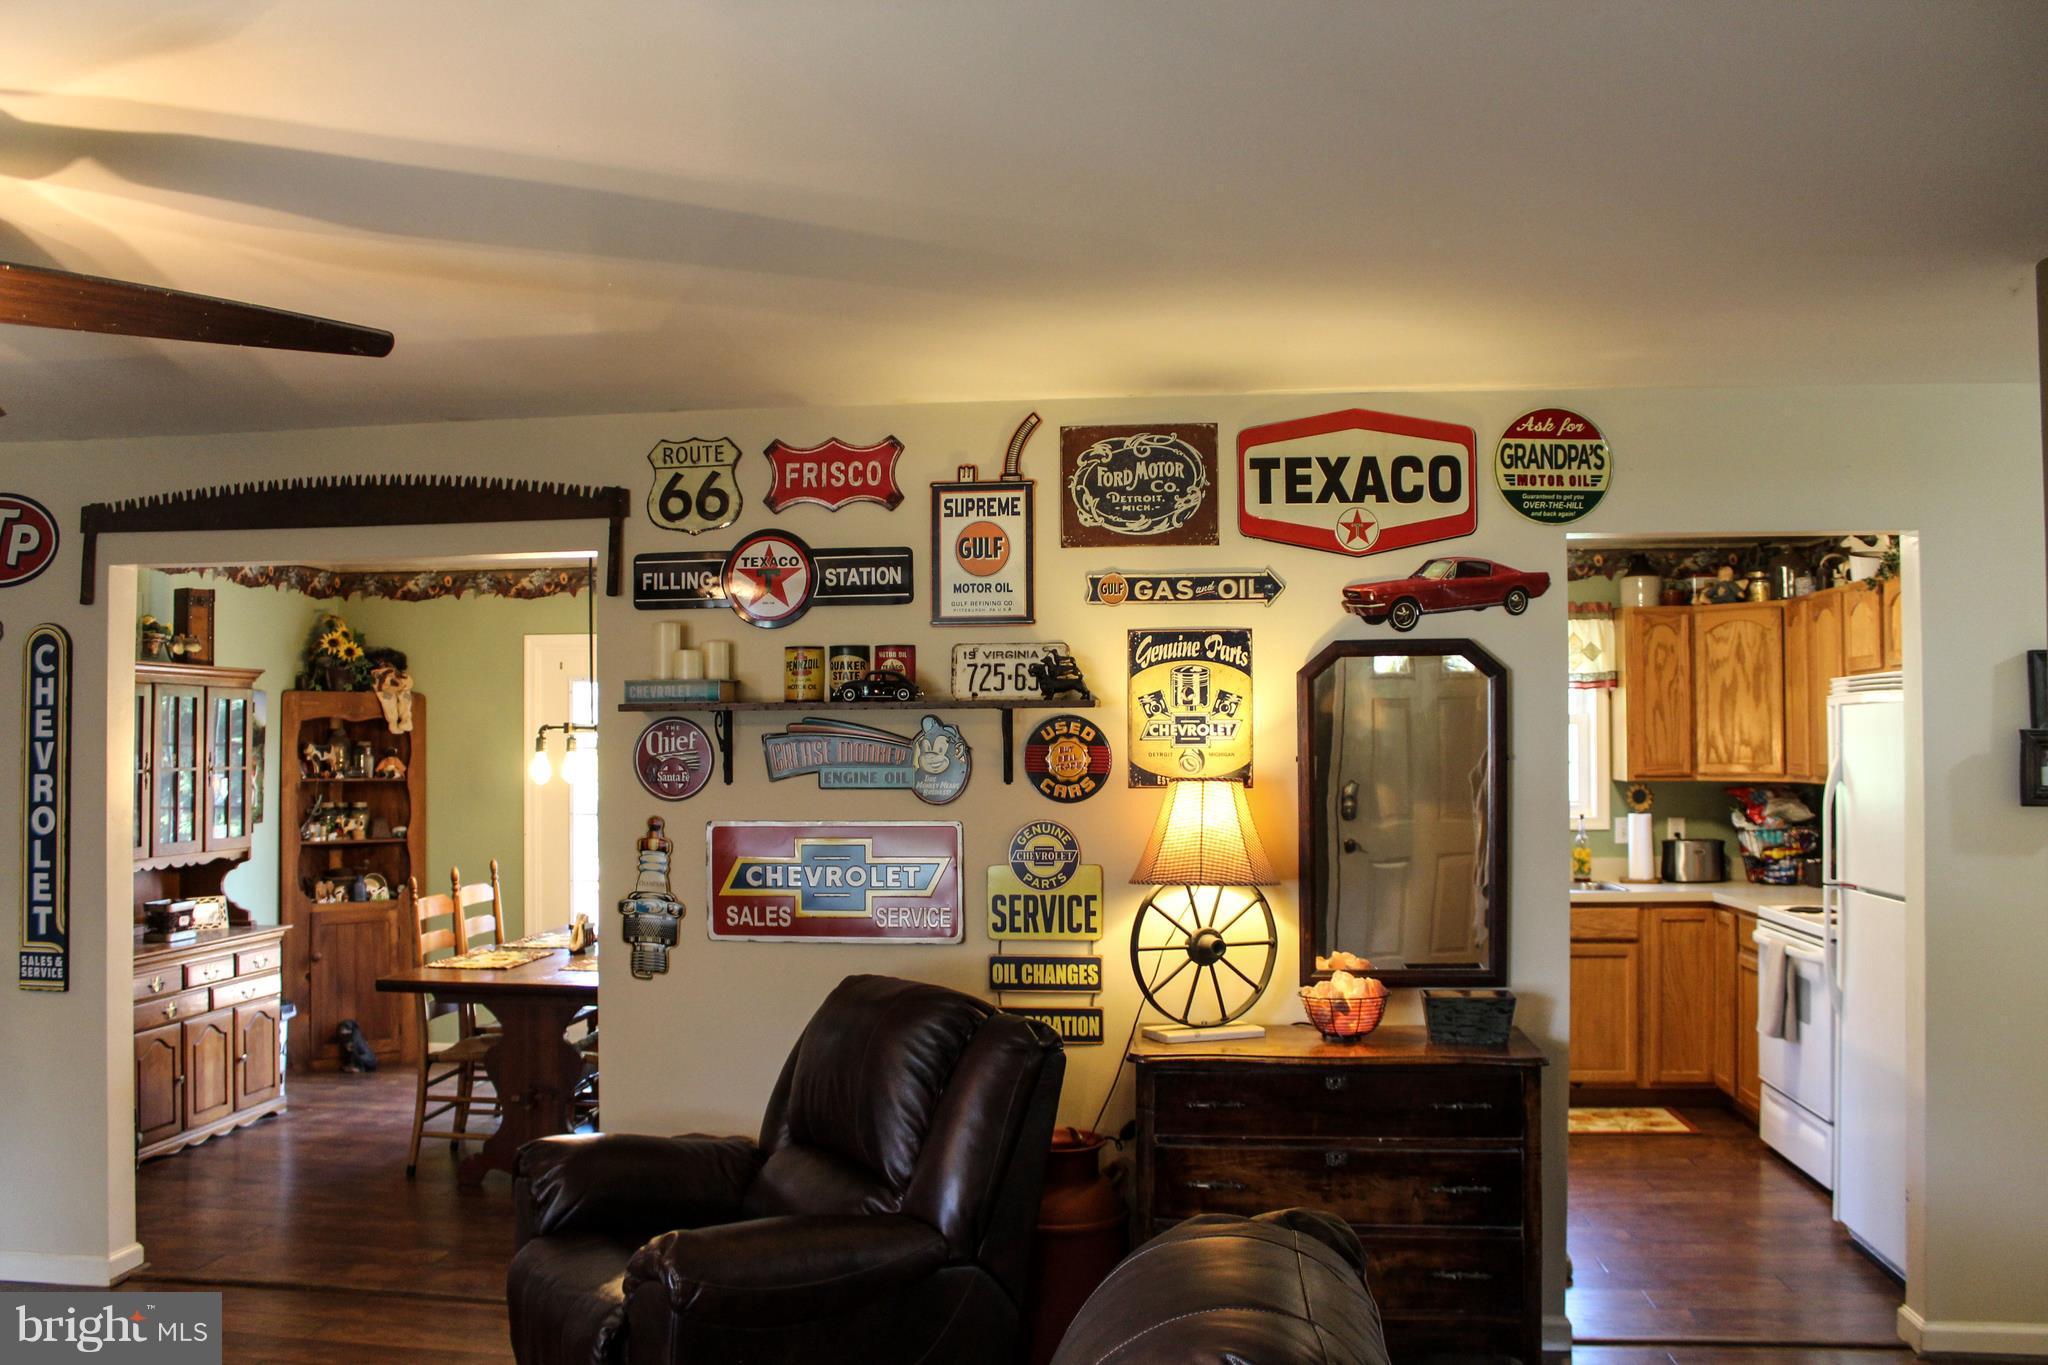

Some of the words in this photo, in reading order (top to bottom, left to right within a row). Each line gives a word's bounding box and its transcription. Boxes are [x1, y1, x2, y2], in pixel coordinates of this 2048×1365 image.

[1516, 416, 1555, 432] Ask
[1556, 417, 1585, 436] for
[663, 445, 724, 464] ROUTE
[1501, 443, 1605, 470] GRANDPA'S
[785, 461, 882, 488] FRISCO
[1097, 466, 1133, 487] FORD
[1126, 461, 1184, 491] MOTOR
[1249, 455, 1462, 504] TEXACO
[1517, 474, 1564, 487] MOTOR
[1569, 475, 1590, 487] OIL
[659, 471, 729, 522] 66
[1523, 501, 1584, 509] OVER-THE-HILL
[944, 497, 1021, 517] SUPREME
[959, 537, 1004, 560] GULF
[741, 556, 799, 568] TEXACO
[642, 571, 713, 590] FILLING
[825, 566, 901, 586] STATION
[953, 583, 992, 594] MOTOR
[995, 583, 1013, 593] OIL
[1101, 583, 1124, 596] GULF
[1134, 580, 1194, 600] GAS
[1195, 581, 1215, 595] and
[1218, 578, 1265, 599] OIL
[983, 651, 1039, 659] VIRGINIA
[1136, 635, 1200, 668] Genuine
[1205, 634, 1248, 667] Parts
[830, 661, 866, 671] QUAKER
[833, 671, 860, 680] STATE
[1041, 721, 1096, 741] USED
[1149, 723, 1234, 737] CHEVROLET
[646, 731, 698, 755] Chief
[657, 771, 680, 782] Santa
[824, 771, 877, 784] ENGINE
[884, 771, 909, 784] OIL
[30, 643, 56, 935] CHEVROLET
[1041, 777, 1096, 798] CARS
[1017, 824, 1071, 845] GENUINE
[1016, 852, 1072, 860] CHEVROLET
[745, 865, 921, 888] CHEVROLET
[1023, 873, 1067, 889] PARTS
[726, 905, 791, 927] SALES
[876, 907, 951, 928] SERVICE
[992, 894, 1098, 934] SERVICE
[21, 956, 53, 966] SALES
[55, 957, 63, 967] &
[21, 967, 63, 978] SERVICE
[992, 963, 1018, 984] OIL
[1021, 963, 1099, 985] CHANGES
